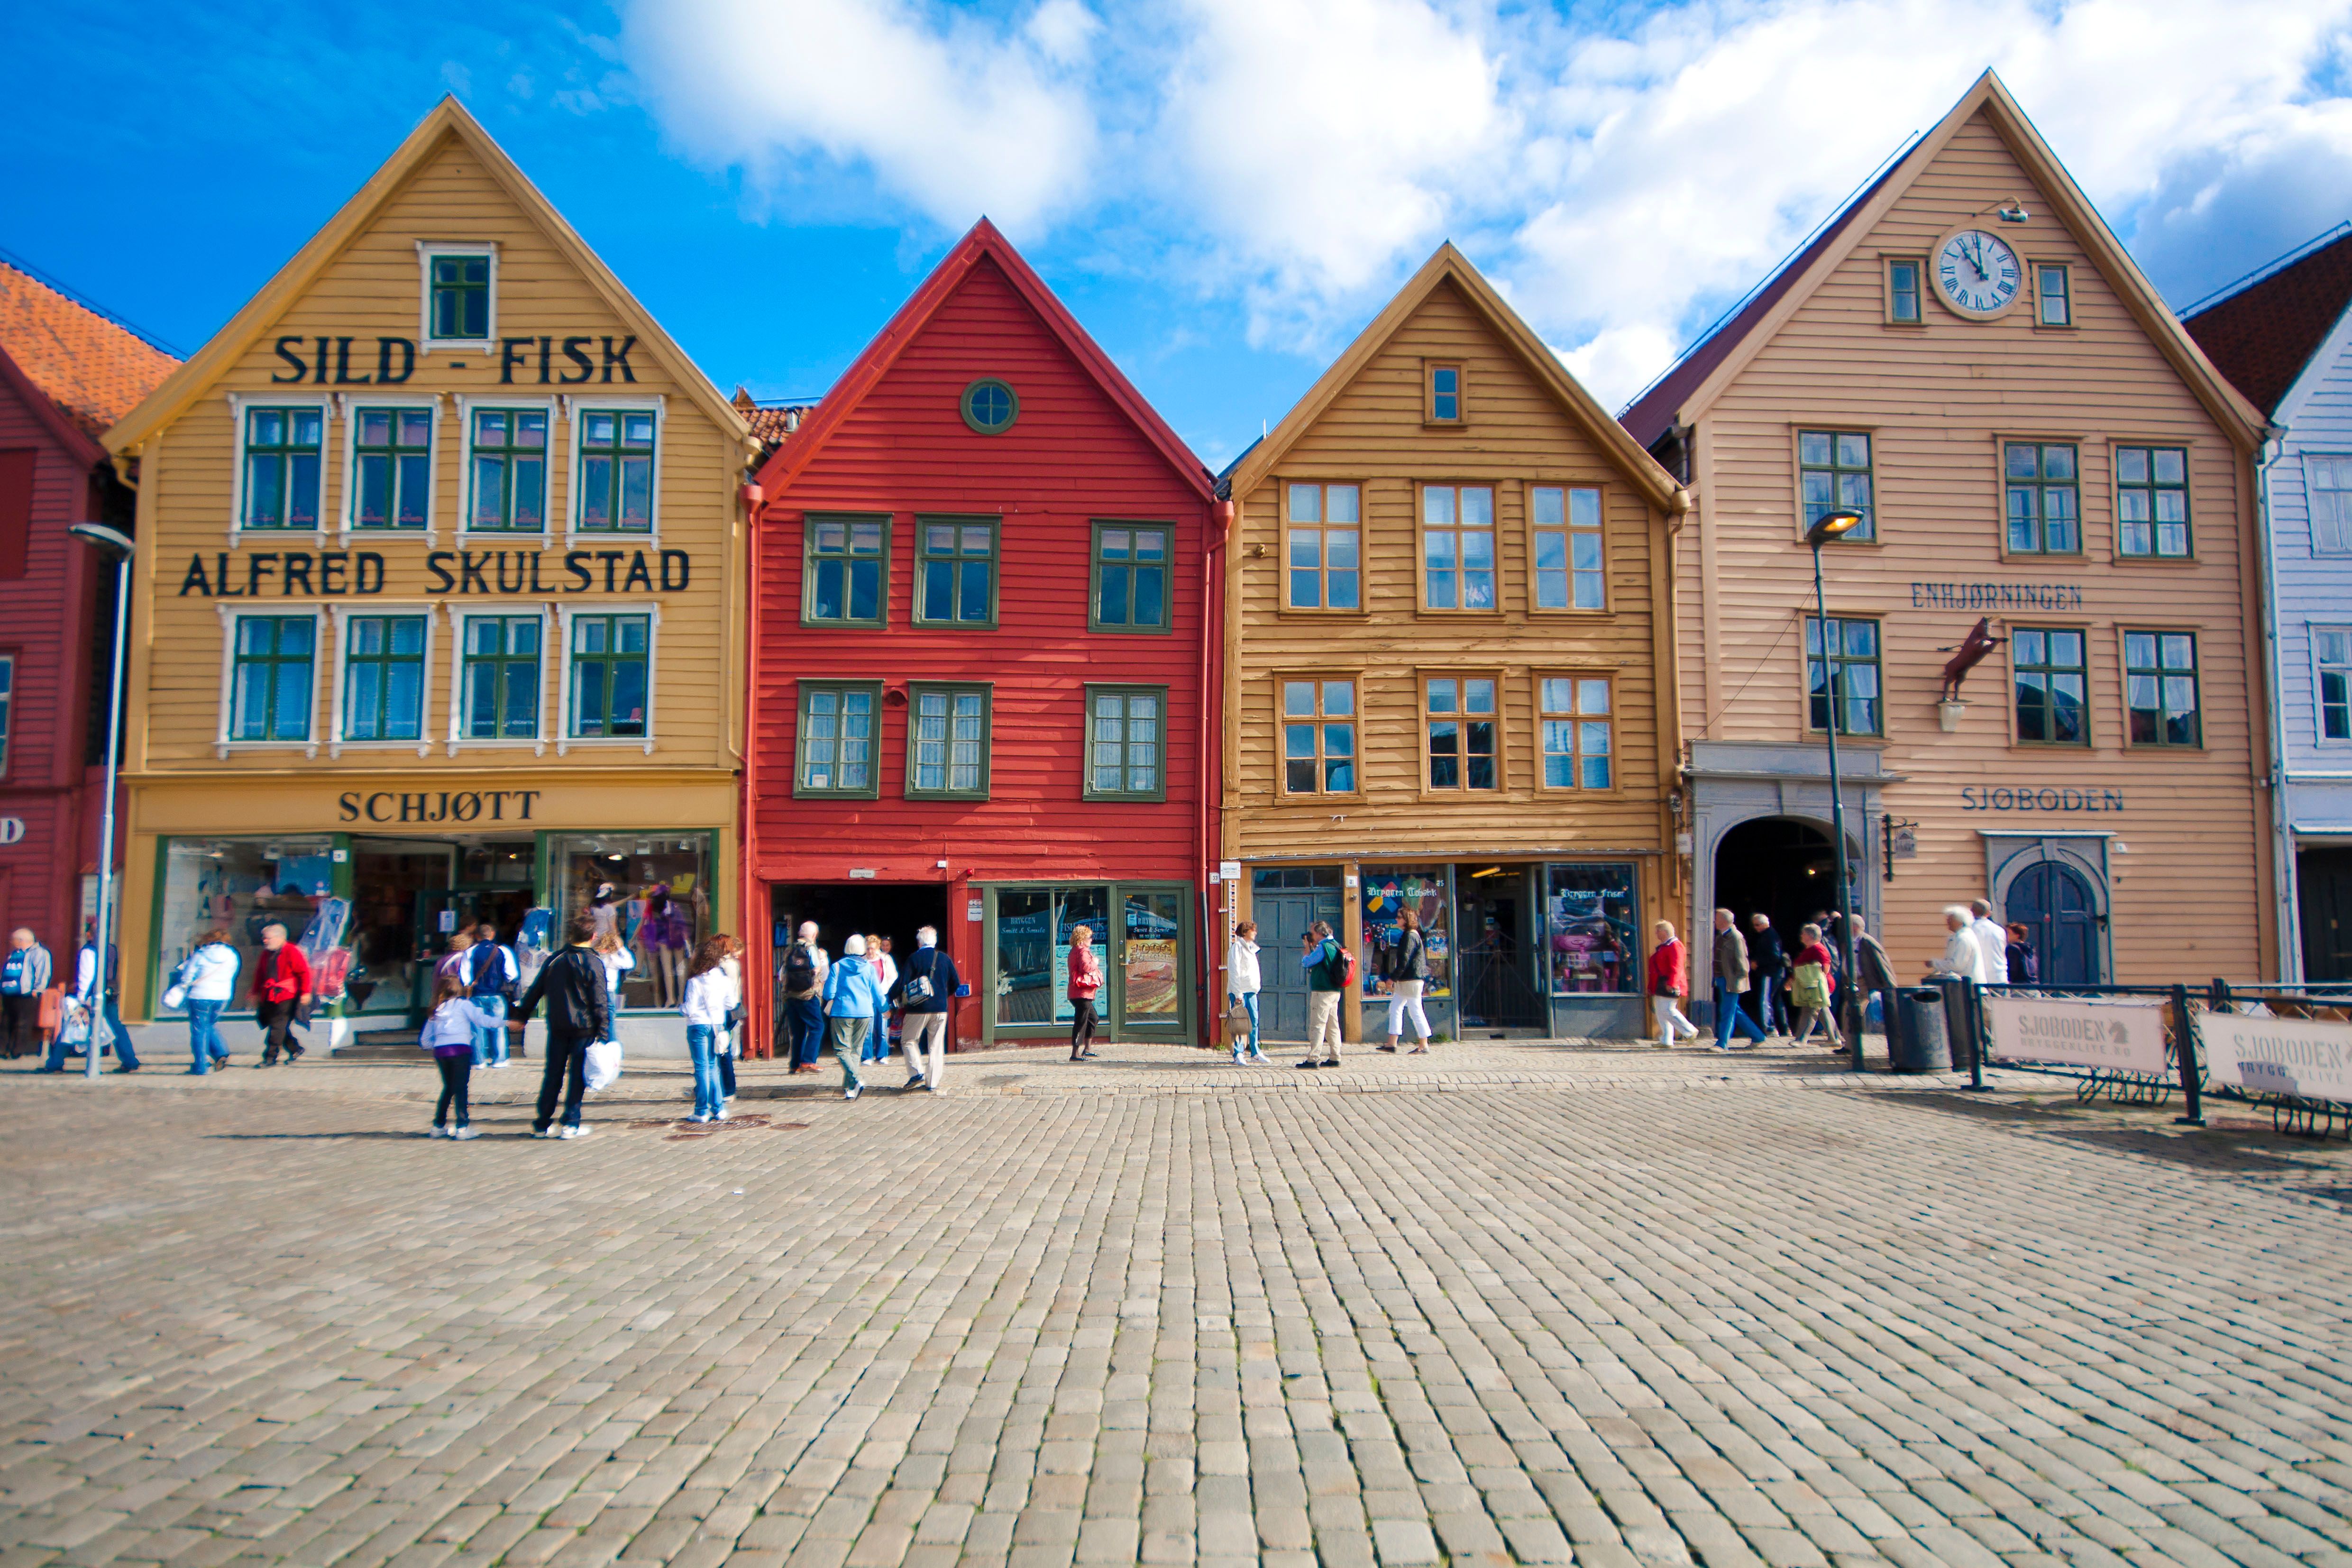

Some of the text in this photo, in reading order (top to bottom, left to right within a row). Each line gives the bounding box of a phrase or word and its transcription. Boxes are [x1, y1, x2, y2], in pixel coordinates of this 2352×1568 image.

[272, 335, 415, 384] SILD
[500, 335, 638, 385] FISK
[178, 549, 690, 596] ALFRED SKULSTAD
[1911, 582, 2083, 611] ENHJØRNINGEN
[339, 790, 540, 822] SCHJØTT
[1962, 788, 2123, 811] SJØBODEN
[1367, 887, 1404, 898] Bryggen
[1561, 889, 1596, 899] Bryggen
